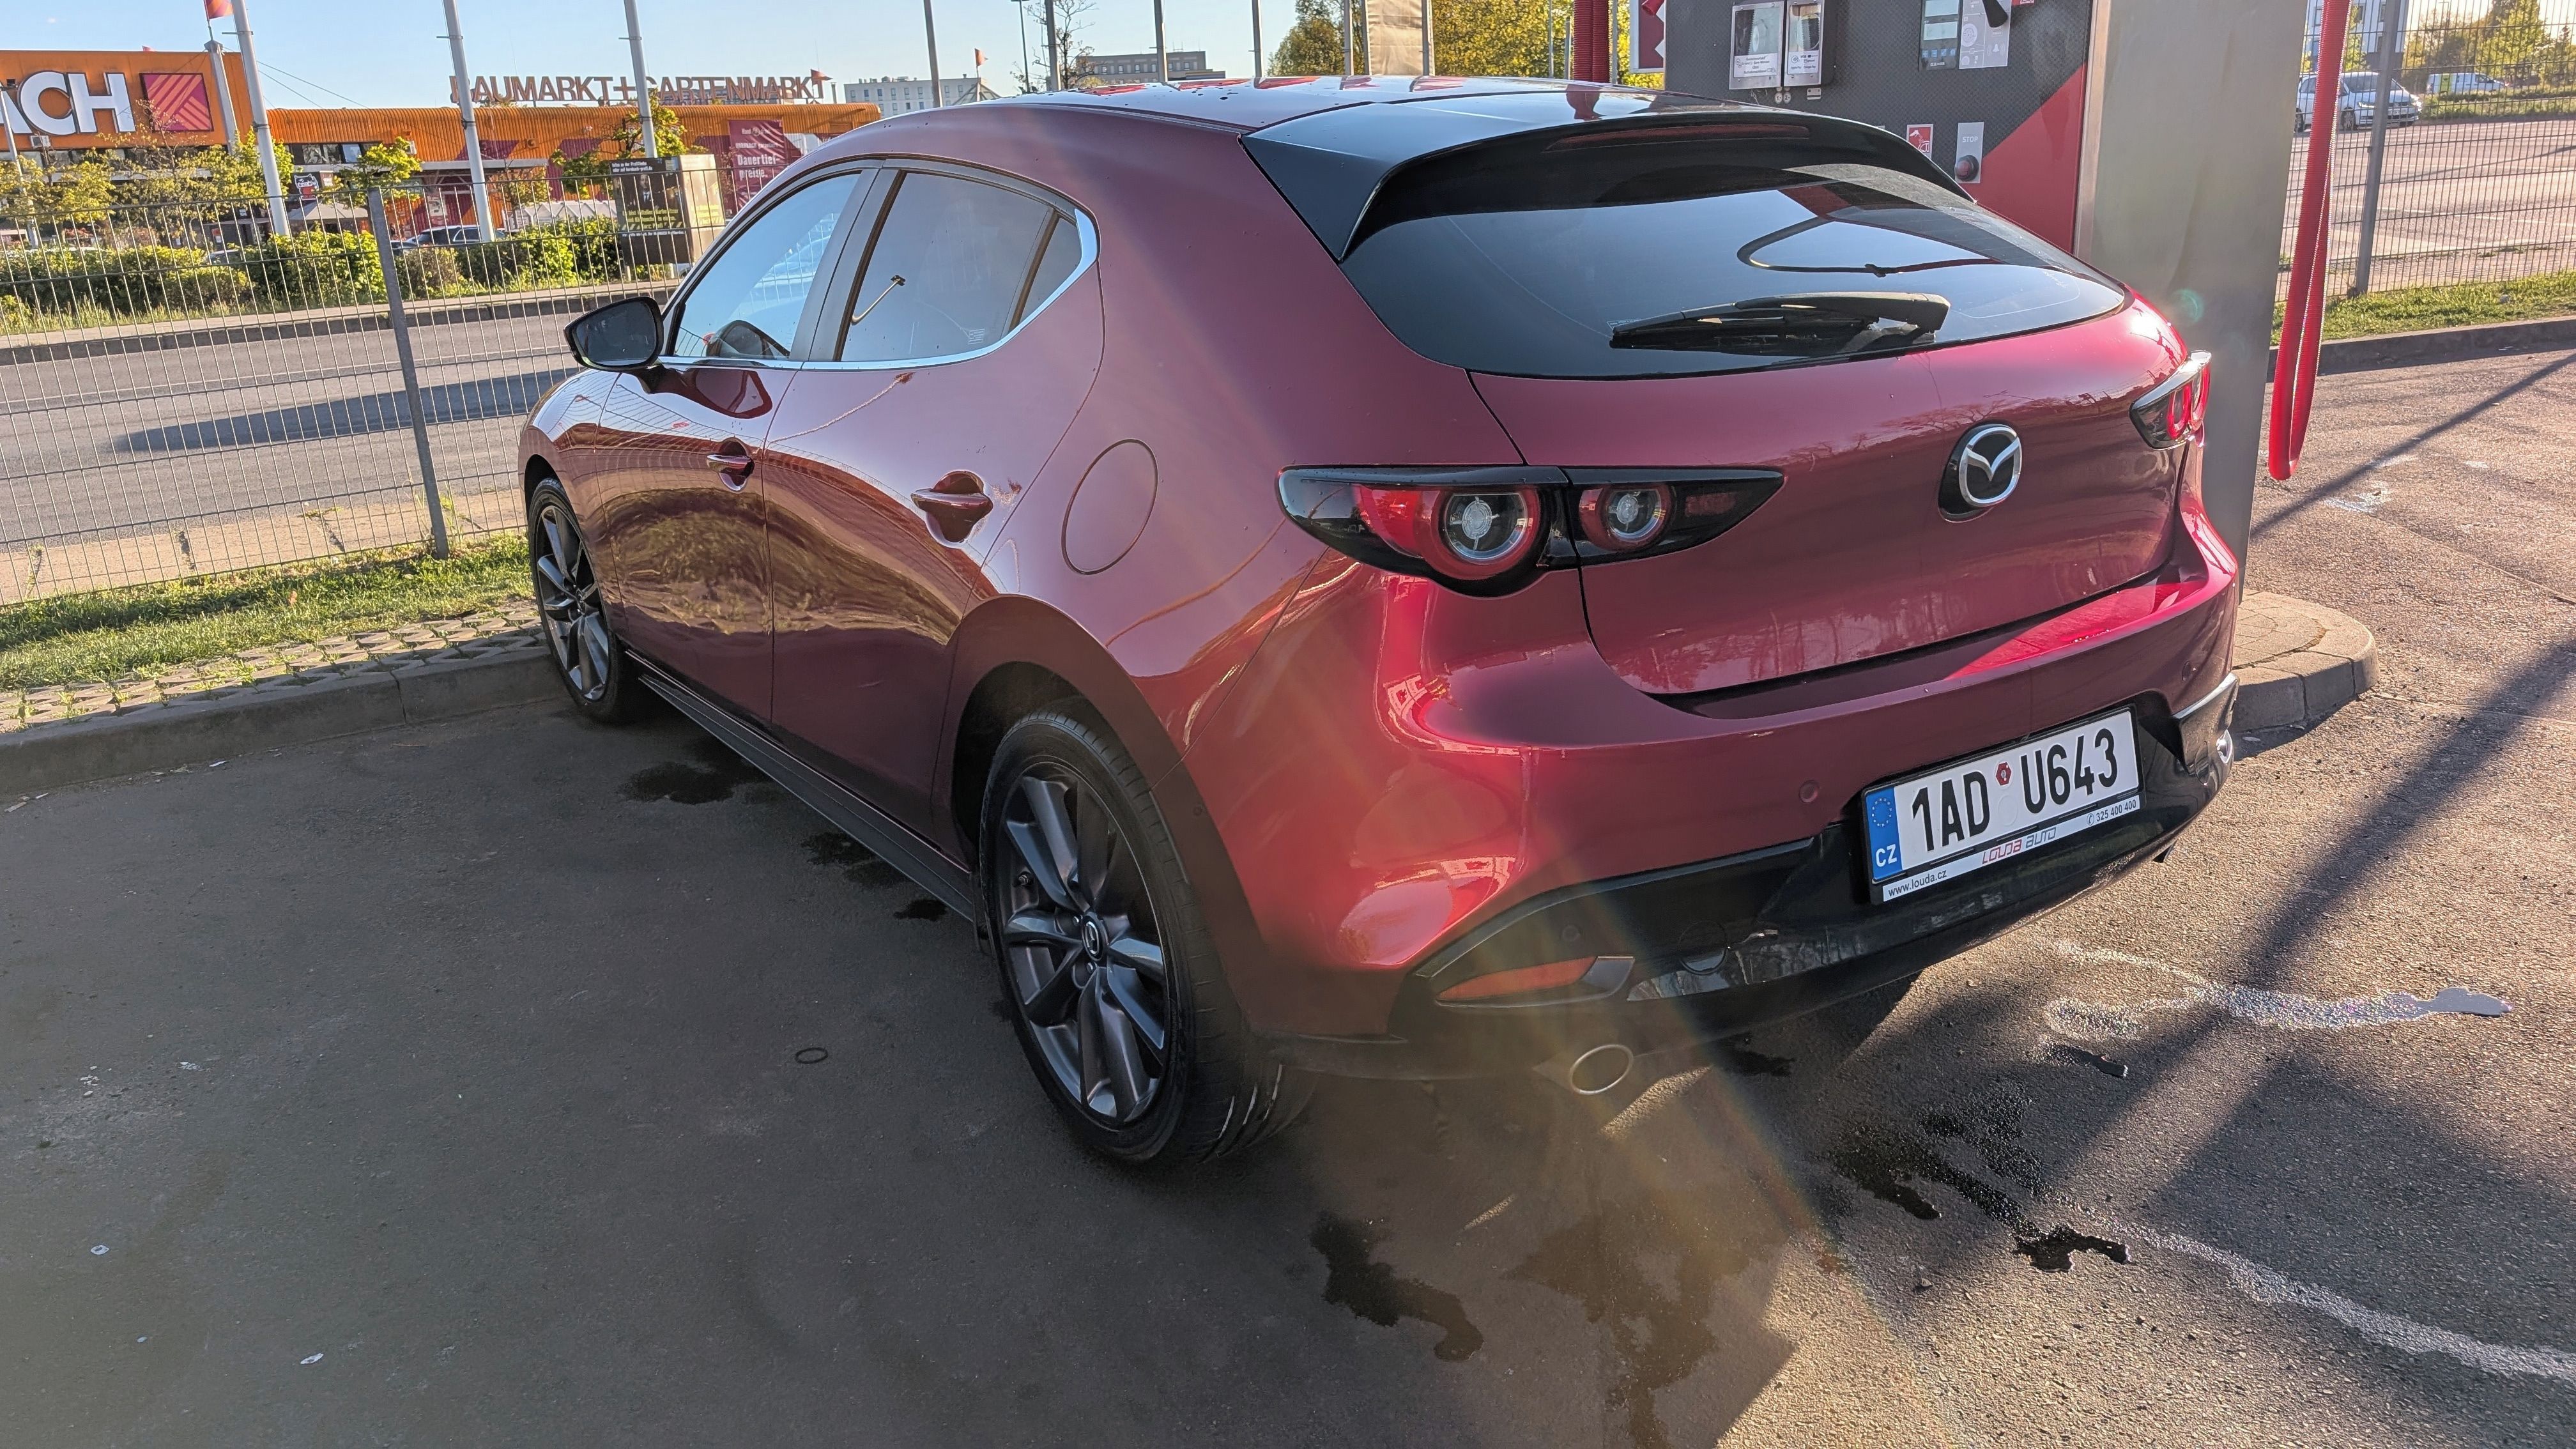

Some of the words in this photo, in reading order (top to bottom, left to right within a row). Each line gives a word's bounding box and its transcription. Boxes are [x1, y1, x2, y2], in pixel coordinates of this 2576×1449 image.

[1912, 770, 1990, 852] 1AD
[2020, 728, 2118, 815] U643
[2096, 809, 2109, 822] 325
[2110, 804, 2123, 817] 400
[2124, 799, 2137, 812] 400
[1875, 843, 1897, 868] CZ
[1887, 869, 1947, 897] www.louda.cz
